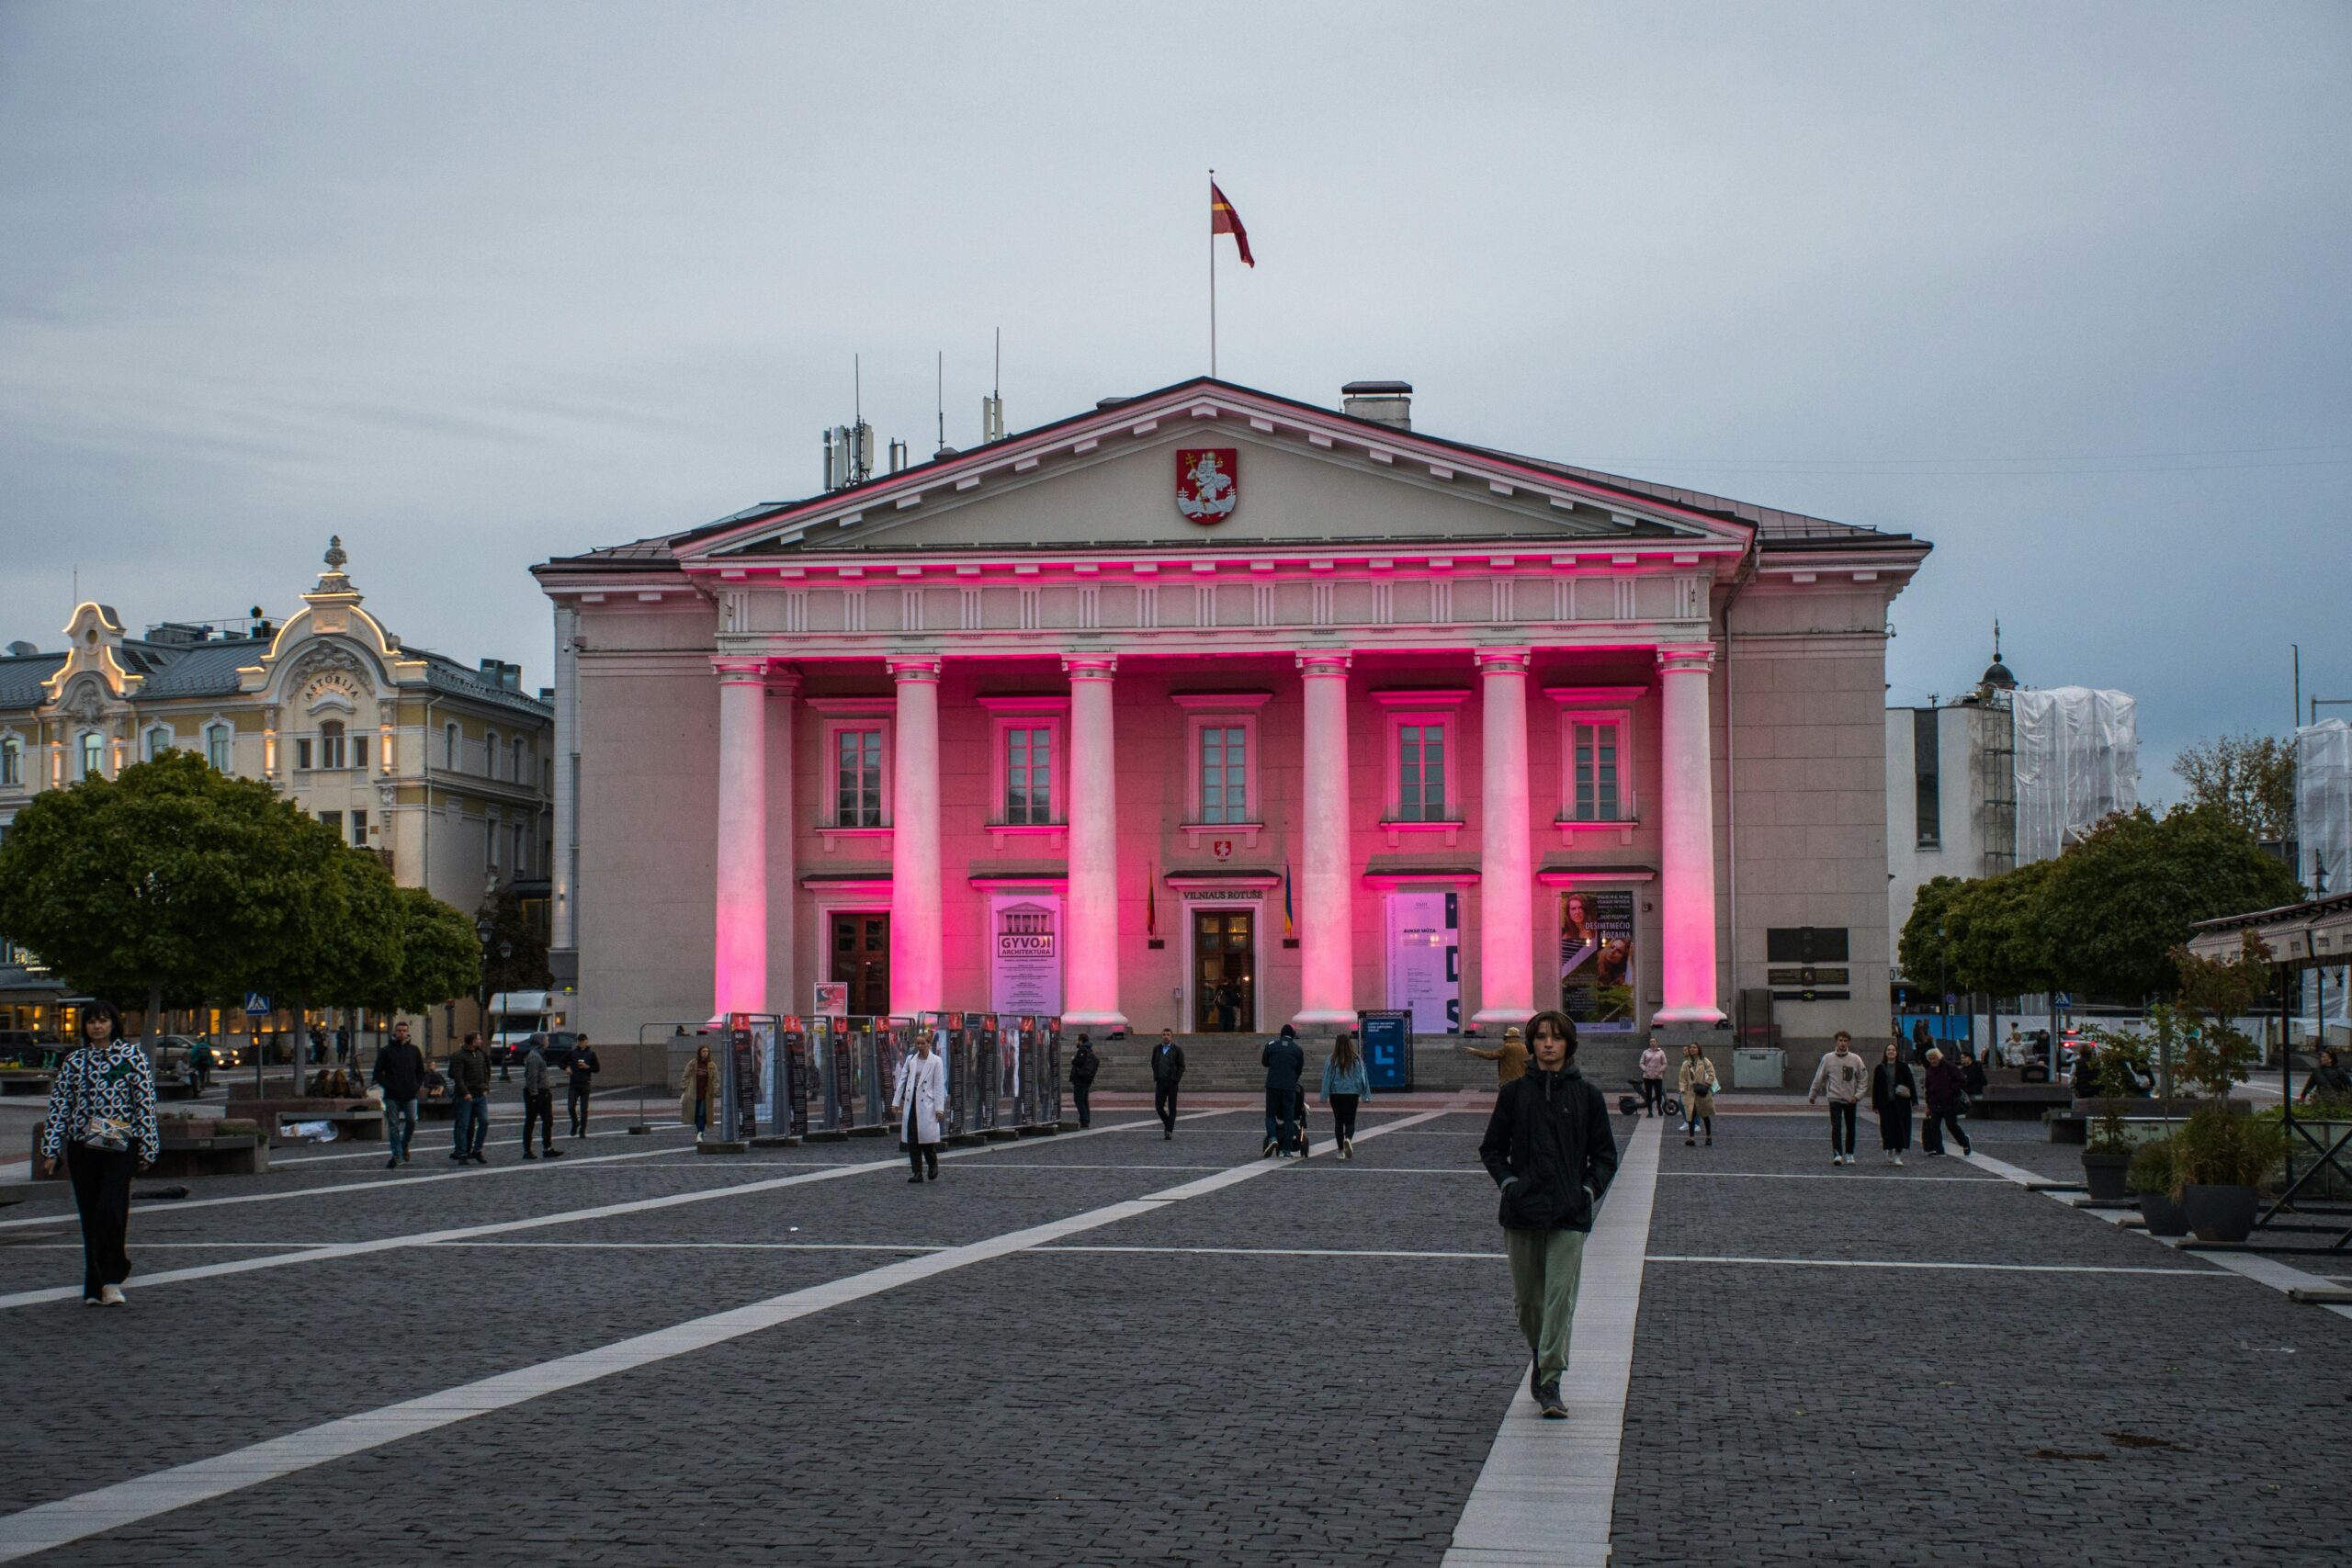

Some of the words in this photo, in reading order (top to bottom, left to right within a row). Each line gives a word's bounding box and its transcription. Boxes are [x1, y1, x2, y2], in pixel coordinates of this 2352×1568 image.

[305, 675, 358, 700] ASTORIJA
[1183, 891, 1227, 899] VILNIAUS
[1227, 889, 1263, 899] ROTUŠĖ
[1585, 921, 1631, 930] DEŠIMTMEČIO
[1001, 937, 1050, 948] GYVOJI
